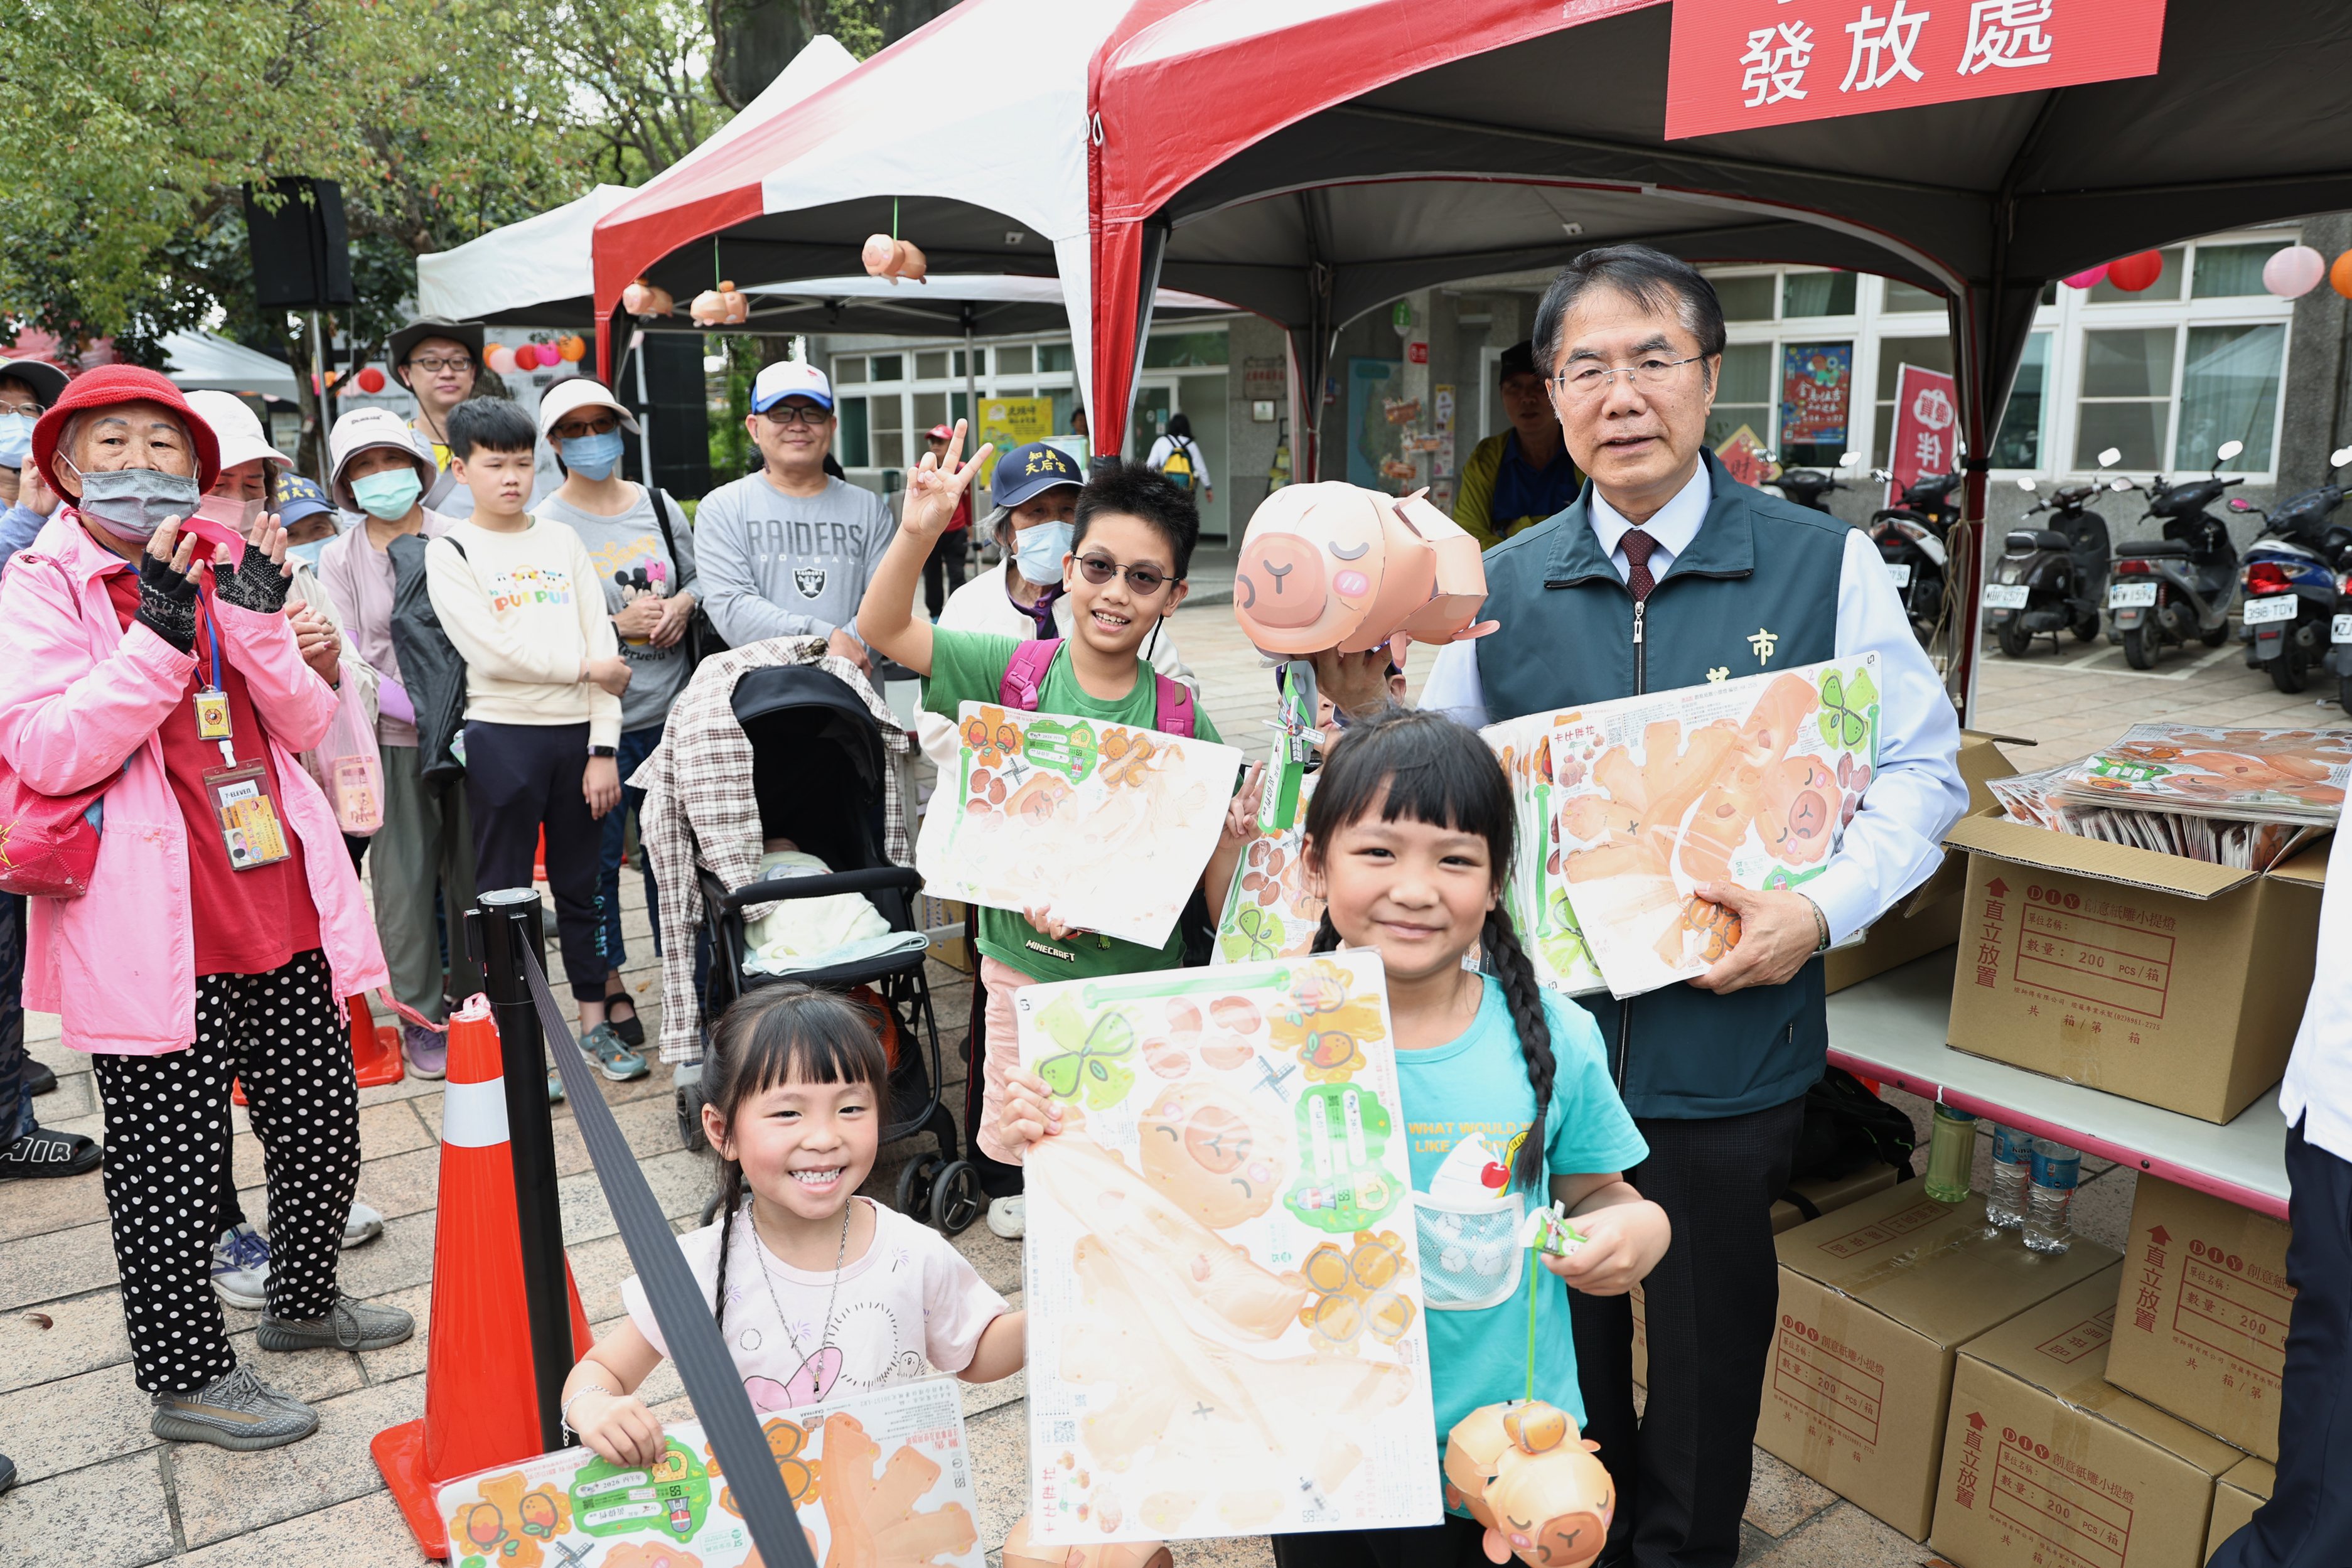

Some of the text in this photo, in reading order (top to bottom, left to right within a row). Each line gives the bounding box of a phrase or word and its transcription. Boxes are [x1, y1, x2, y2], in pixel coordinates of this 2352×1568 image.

[1739, 0, 2053, 108] 發放處
[1025, 459, 1066, 476] 天后宮
[746, 520, 862, 558] RAIDERS
[1807, 669, 1815, 681] 2
[1554, 725, 1595, 744] 卡比胖拉
[225, 788, 252, 798] 7-ELEVEN
[2028, 886, 2176, 932] DIY 創意紙雕小提燈
[1025, 939, 1075, 963] MINECRAFT
[1975, 899, 2006, 989] 直立放置
[2078, 952, 2105, 968] 200
[2027, 1004, 2039, 1016] 共
[2063, 1014, 2075, 1027] 箱
[2128, 1031, 2140, 1044] 箱
[1408, 1122, 1455, 1134] WHAT
[1459, 1122, 1516, 1134] WOULD
[0, 1137, 71, 1163] AIR
[1415, 1140, 1451, 1152] LIKE
[1830, 1230, 1883, 1254] 易碎品
[2191, 1241, 2242, 1270] DIY
[2134, 1244, 2167, 1333] 直立放置
[2239, 1314, 2267, 1335] 200
[1783, 1315, 1885, 1378] DIY 創意紙雕小提燈
[2048, 1327, 2105, 1356] 易碎品
[1817, 1377, 1837, 1394] 200
[2186, 1356, 2198, 1370] 共
[2222, 1373, 2234, 1388] 箱
[1783, 1412, 1792, 1422] 共
[1808, 1425, 1816, 1437] 箱
[1852, 1451, 1861, 1463] 箱
[1954, 1429, 1984, 1510] 直立放置
[2004, 1427, 2135, 1505] DIY 創意紙雕小提燈
[603, 1474, 642, 1488] 2026 丙午年
[2047, 1499, 2071, 1519] 200
[2000, 1534, 2012, 1547] 共
[2032, 1551, 2044, 1565] 箱
